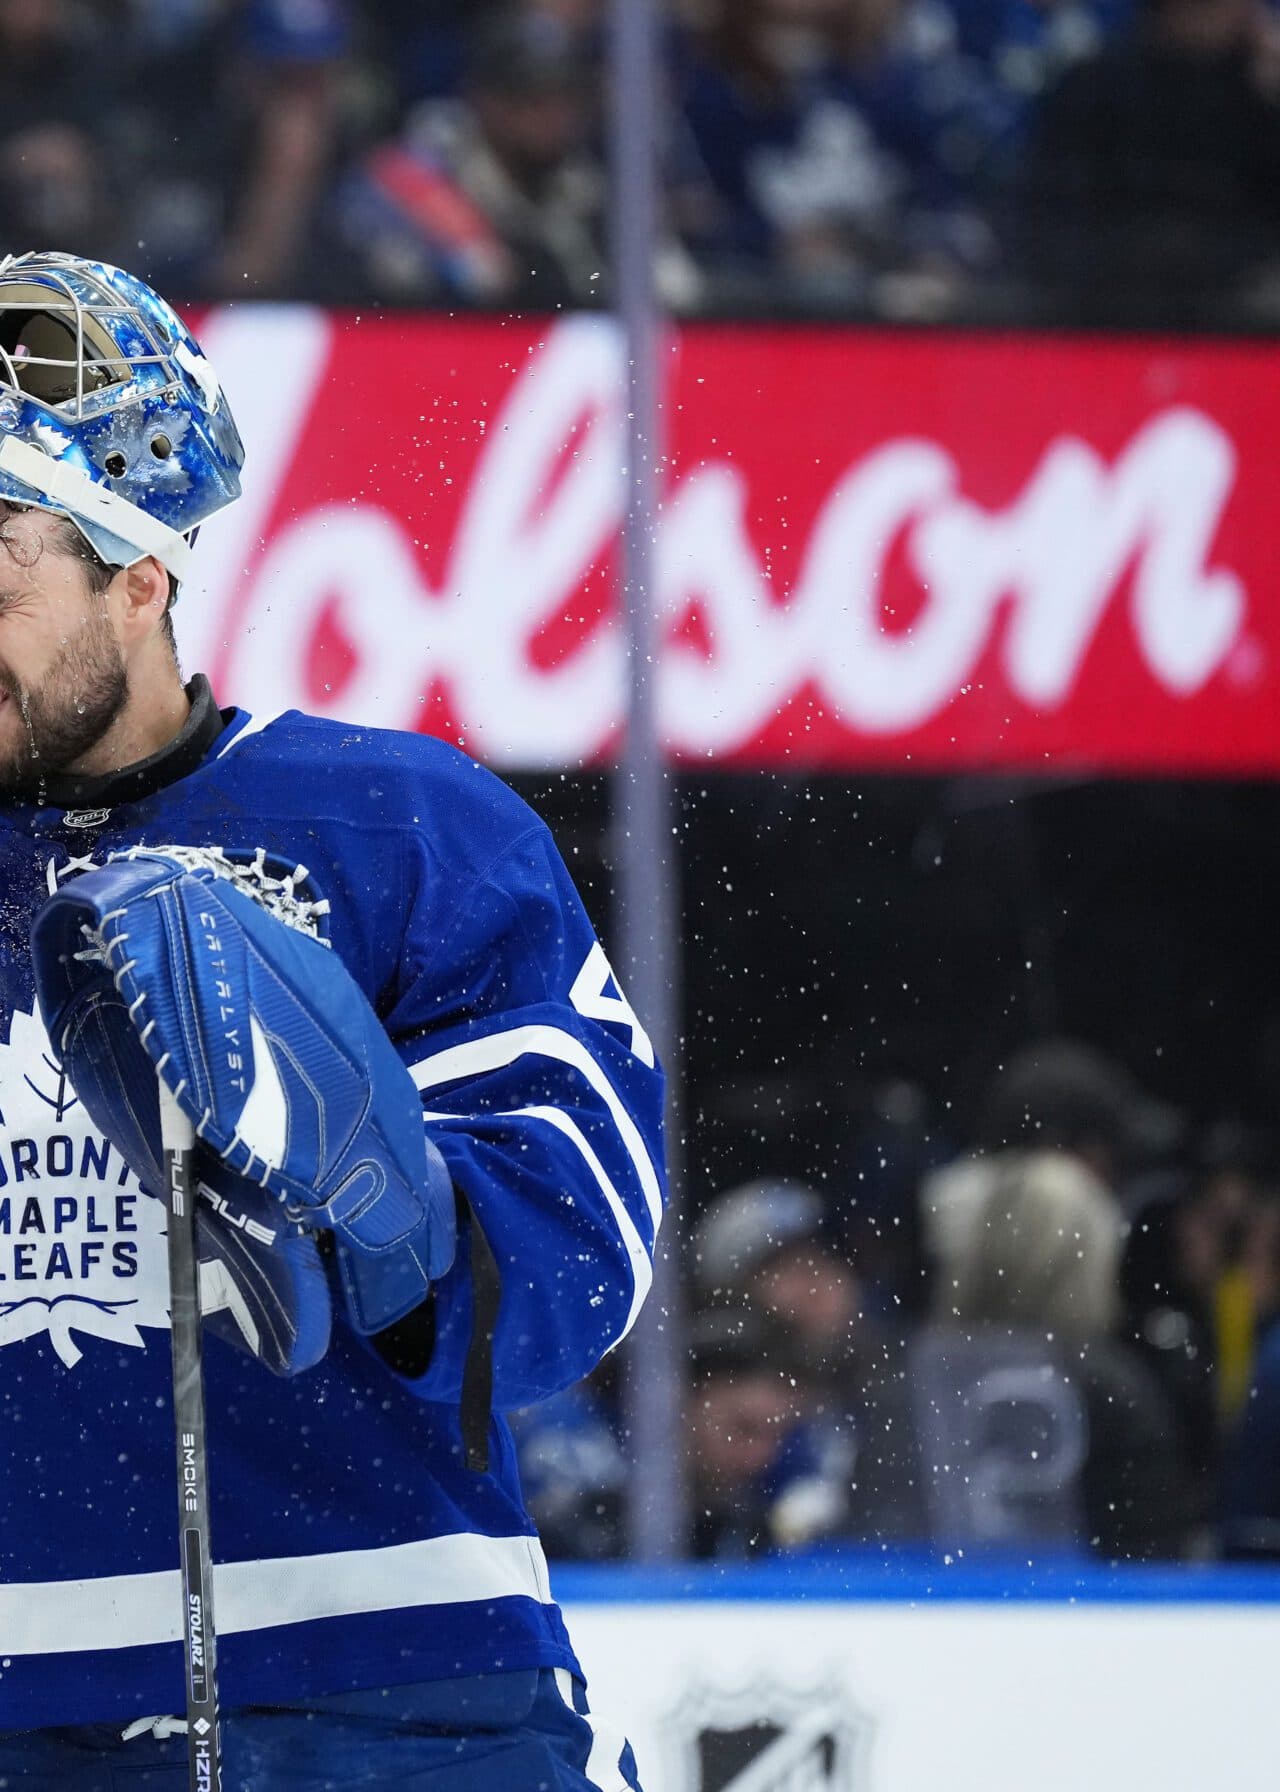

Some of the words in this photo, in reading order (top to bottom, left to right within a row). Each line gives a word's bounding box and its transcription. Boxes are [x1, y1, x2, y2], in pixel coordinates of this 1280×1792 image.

[200, 912, 245, 1093] CATALYST
[182, 1433, 197, 1512] SMOKE
[189, 1594, 204, 1667] STOLARZ
